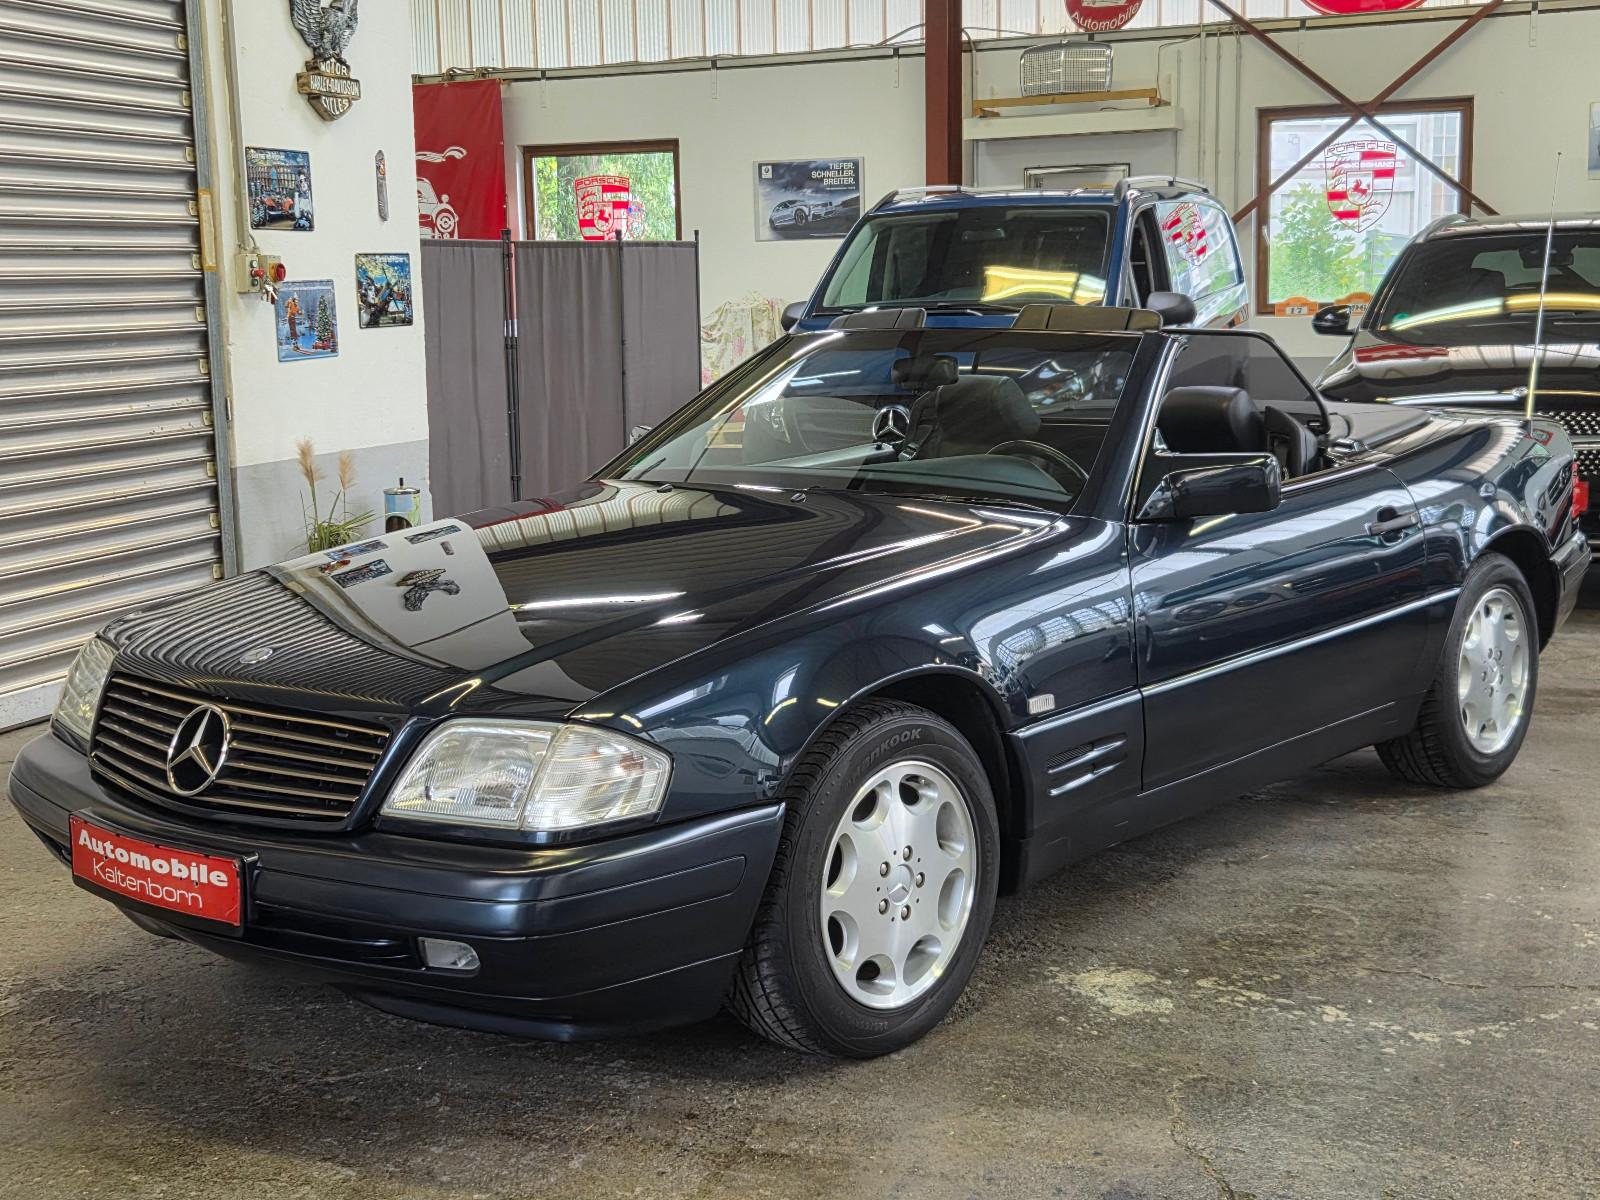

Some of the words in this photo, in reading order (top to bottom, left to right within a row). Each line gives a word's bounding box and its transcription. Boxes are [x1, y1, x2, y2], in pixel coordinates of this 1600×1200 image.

[1071, 2, 1140, 31] Automobile
[319, 58, 348, 76] MOTOR
[310, 75, 360, 96] HARLEY-DAVIDSON
[321, 96, 349, 115] CYCLES
[1326, 142, 1397, 156] PORSCHE
[811, 170, 855, 179] SCHNELLER.
[829, 162, 855, 170] TIEFER.
[575, 177, 629, 188] PORSCHE
[823, 178, 856, 186] BREITER.
[78, 829, 229, 887] Automobile
[92, 858, 203, 909] Kaltenborn
